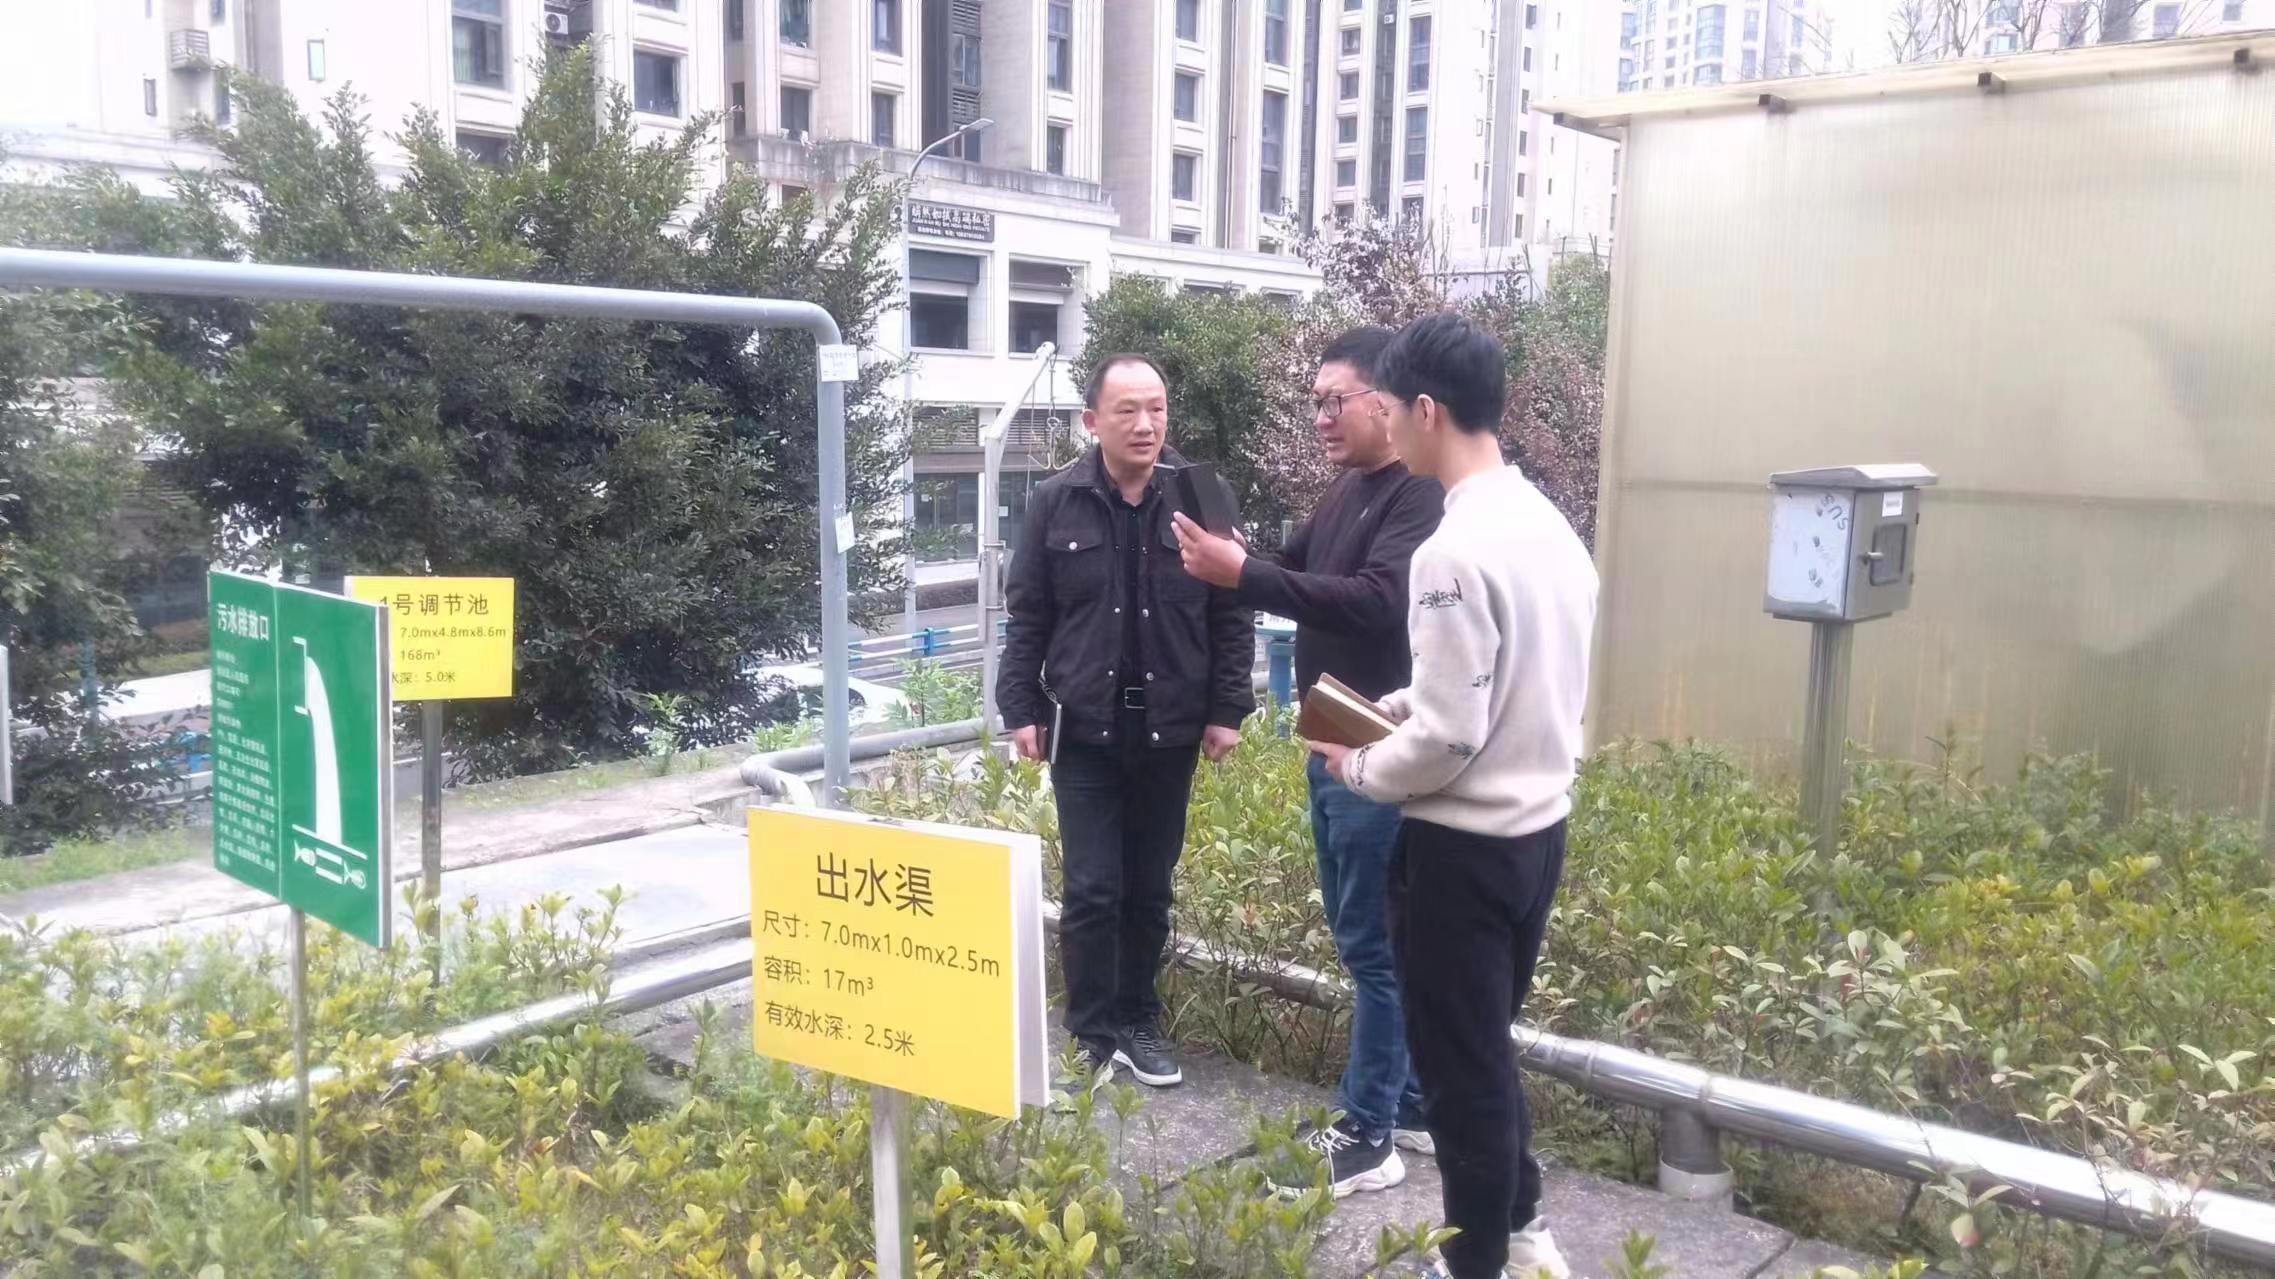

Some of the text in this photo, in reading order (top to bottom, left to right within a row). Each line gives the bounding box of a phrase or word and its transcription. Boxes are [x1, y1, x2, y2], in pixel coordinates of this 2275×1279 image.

[216, 602, 270, 641] 污水排放口
[816, 851, 934, 918] 出水渠
